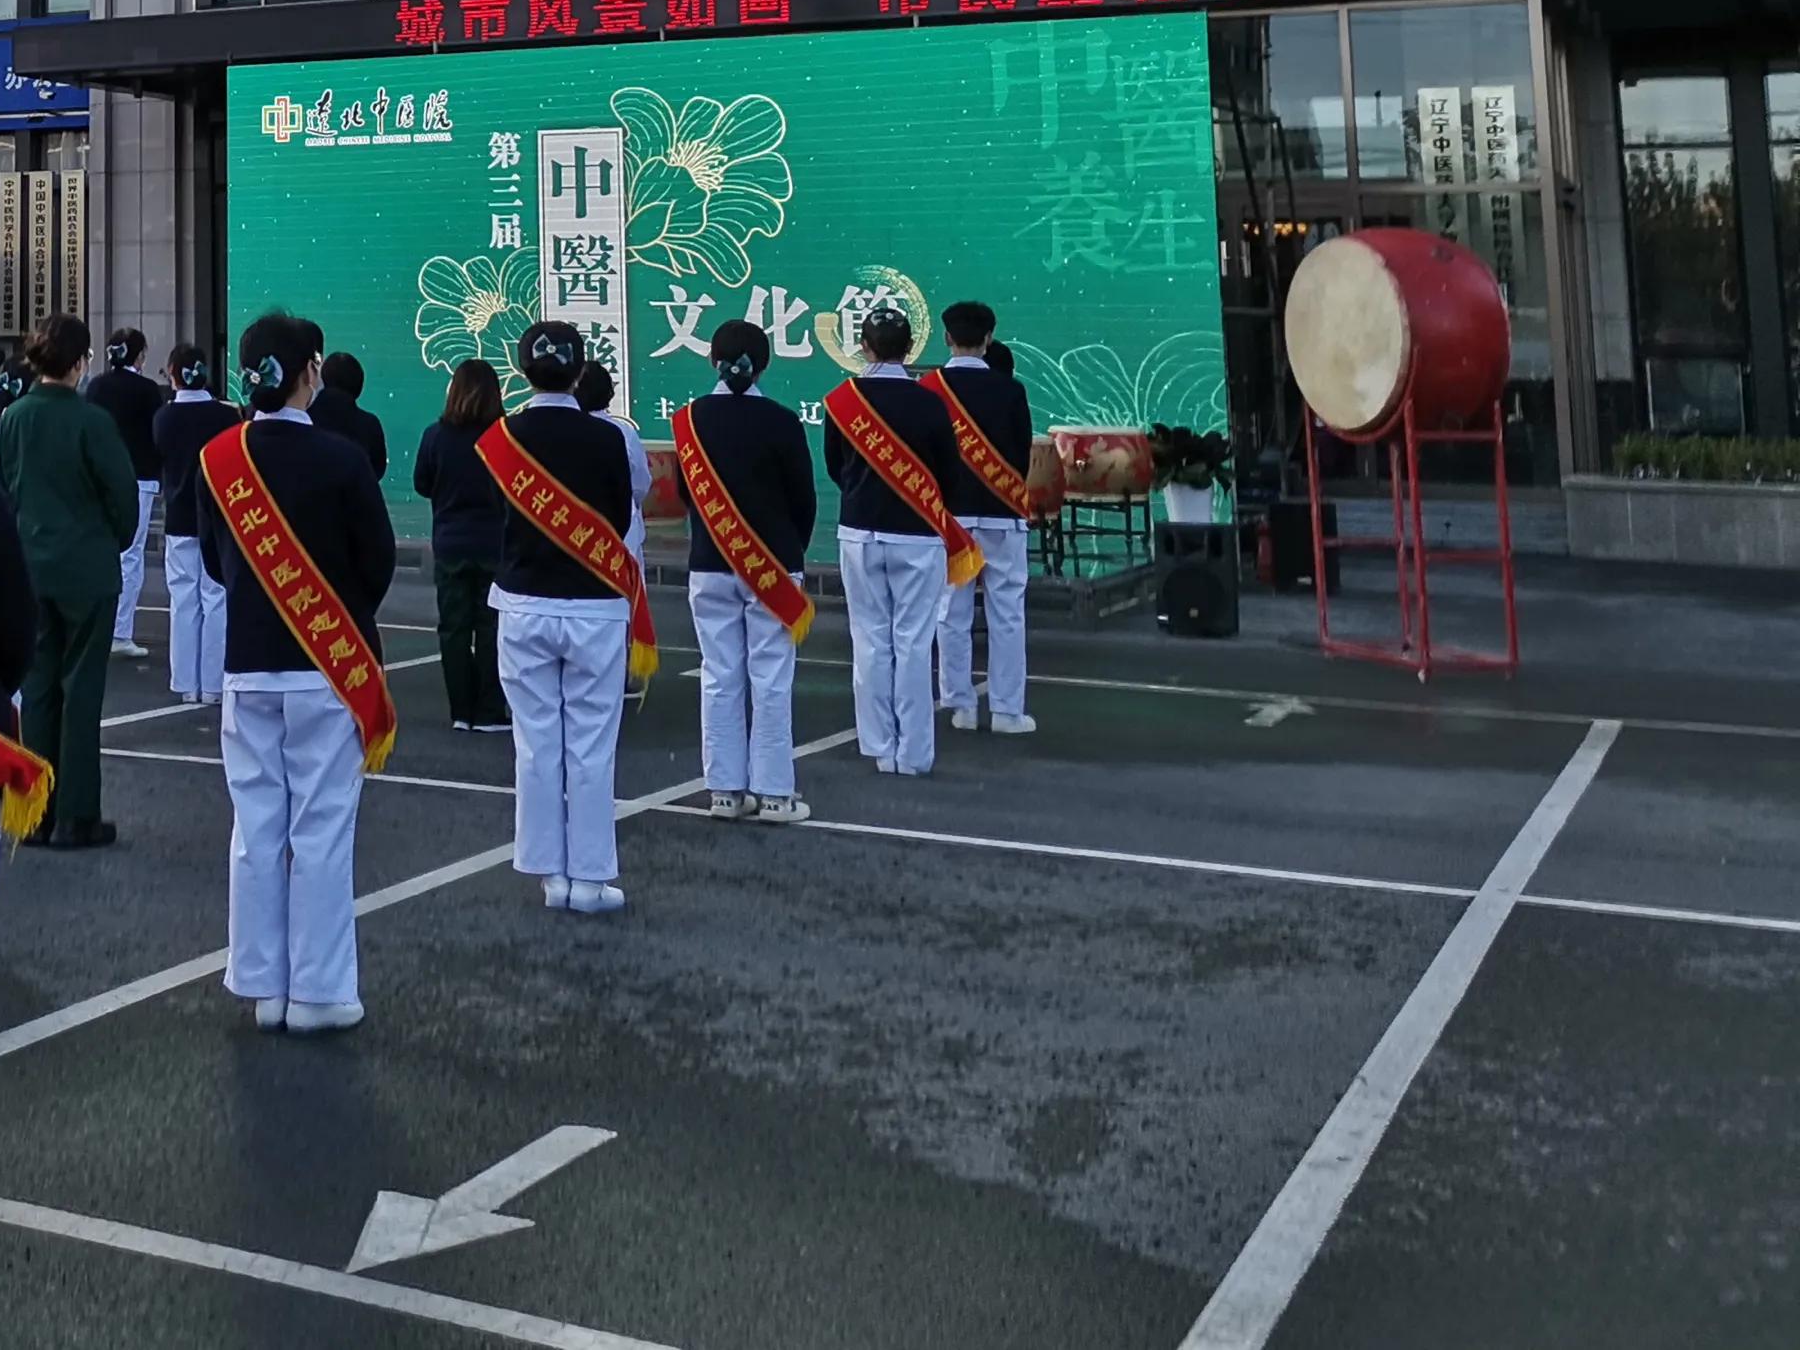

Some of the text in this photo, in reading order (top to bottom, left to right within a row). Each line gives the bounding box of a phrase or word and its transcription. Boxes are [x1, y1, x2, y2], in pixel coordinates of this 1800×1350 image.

[487, 131, 523, 250] 第三届
[225, 477, 370, 692] 辽北中医院志愿者
